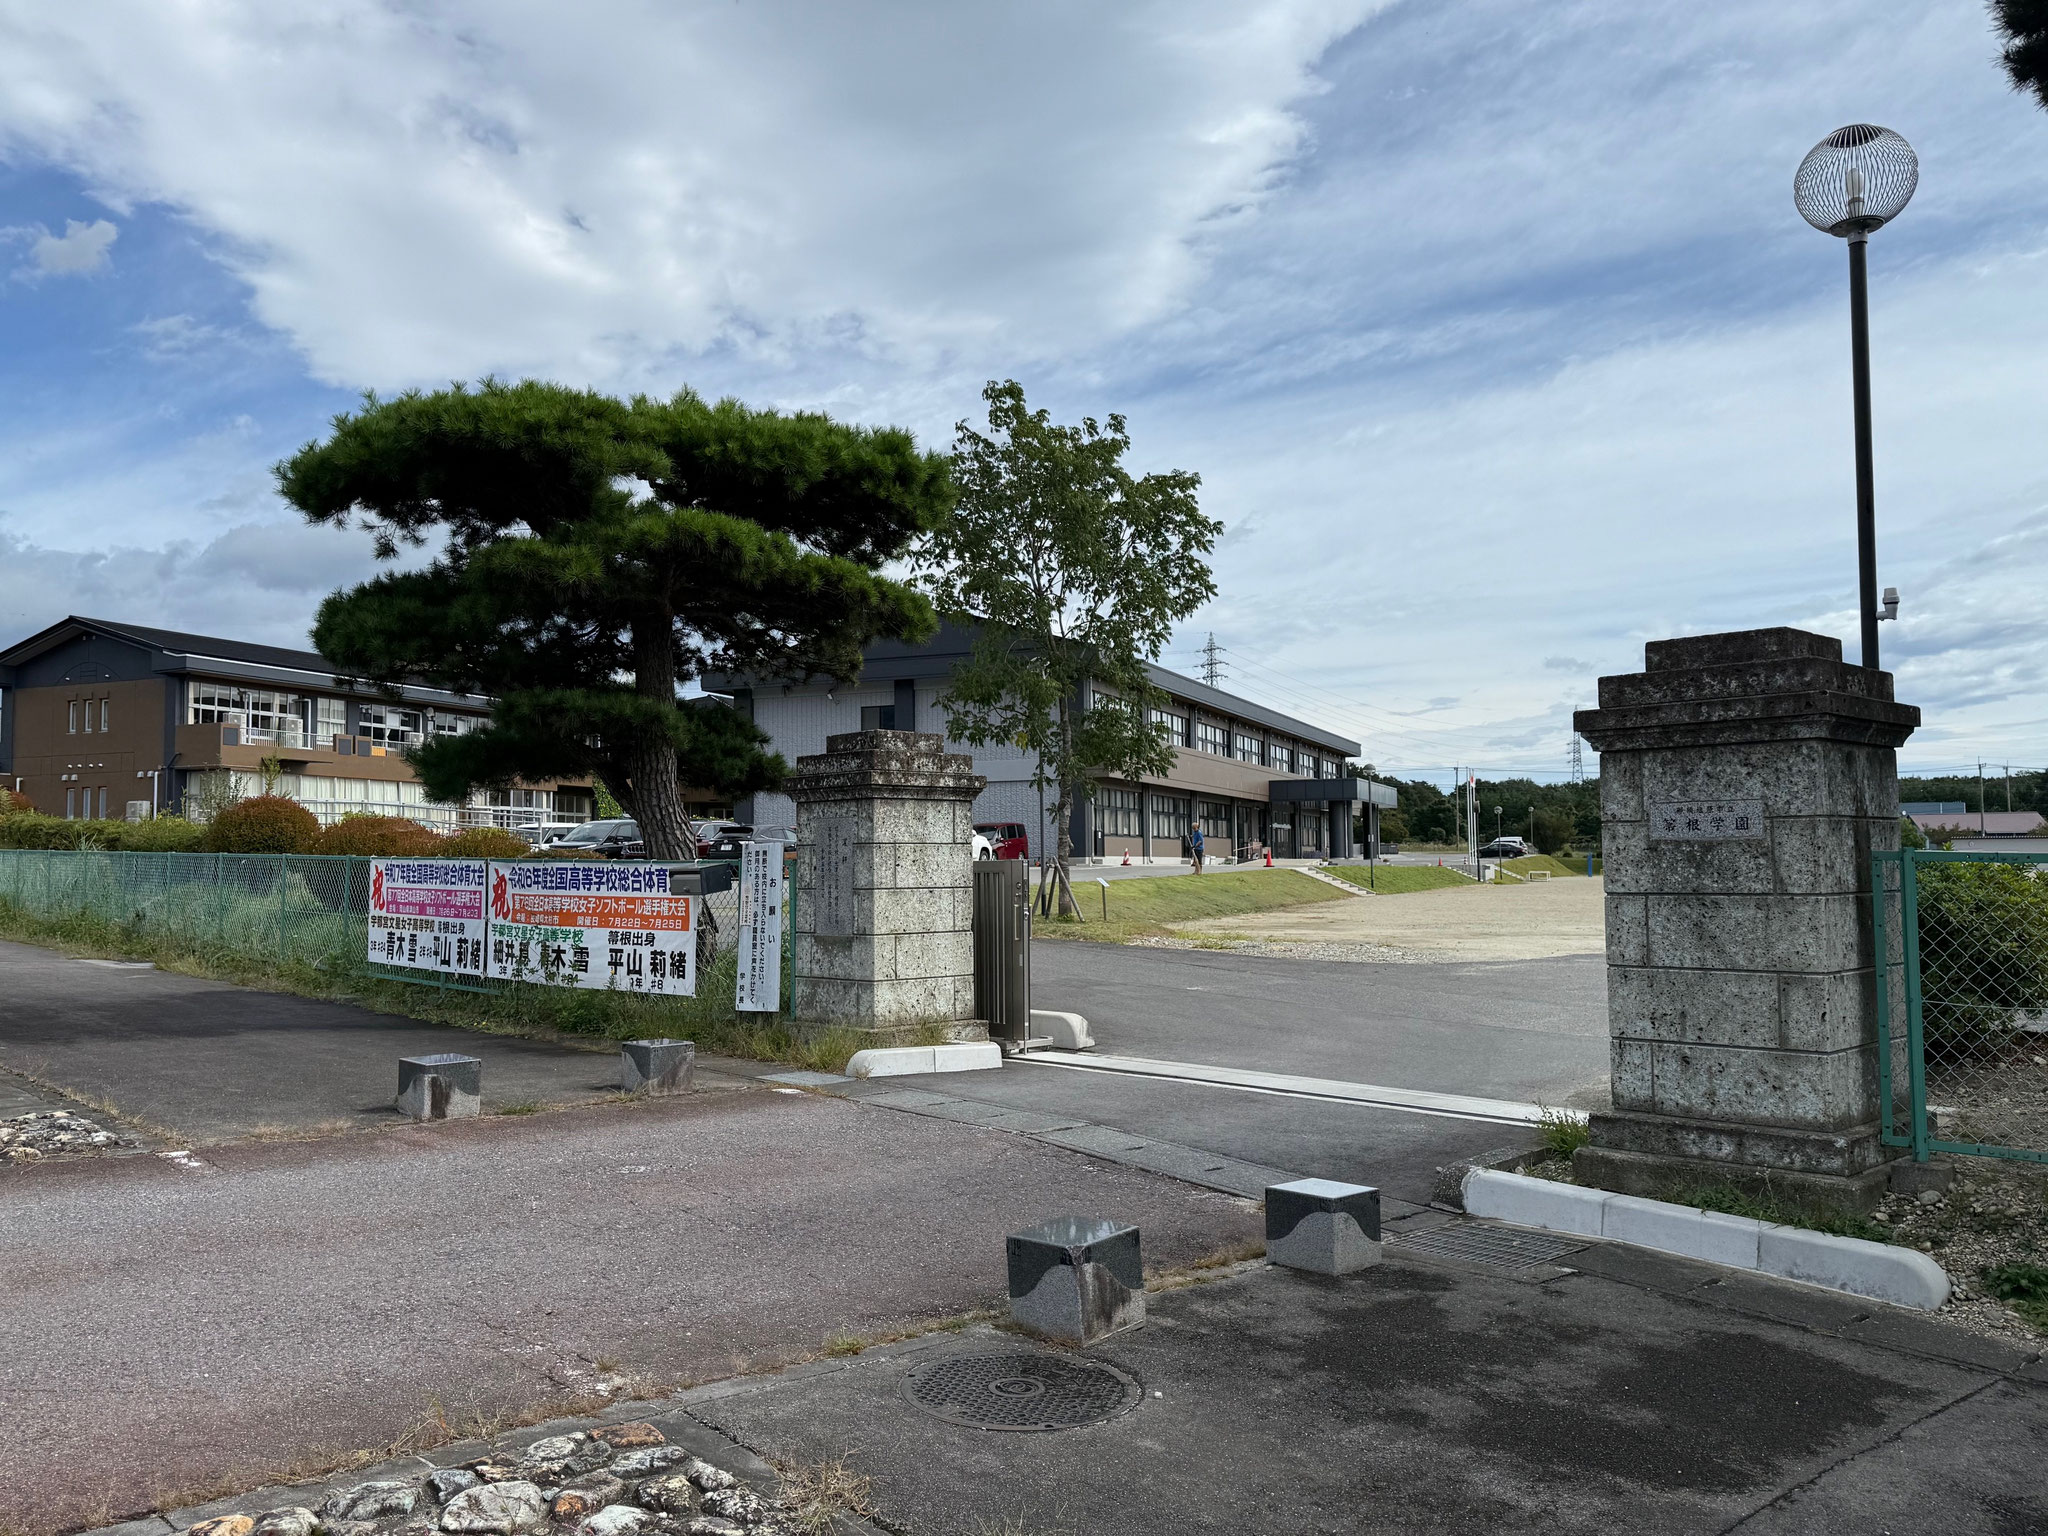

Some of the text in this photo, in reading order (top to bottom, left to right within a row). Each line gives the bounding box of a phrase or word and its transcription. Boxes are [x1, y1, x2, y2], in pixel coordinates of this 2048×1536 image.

[371, 865, 386, 911] 祝
[491, 867, 512, 920] 祝
[509, 866, 672, 893] 令和6年度全国高等学校総合体育
